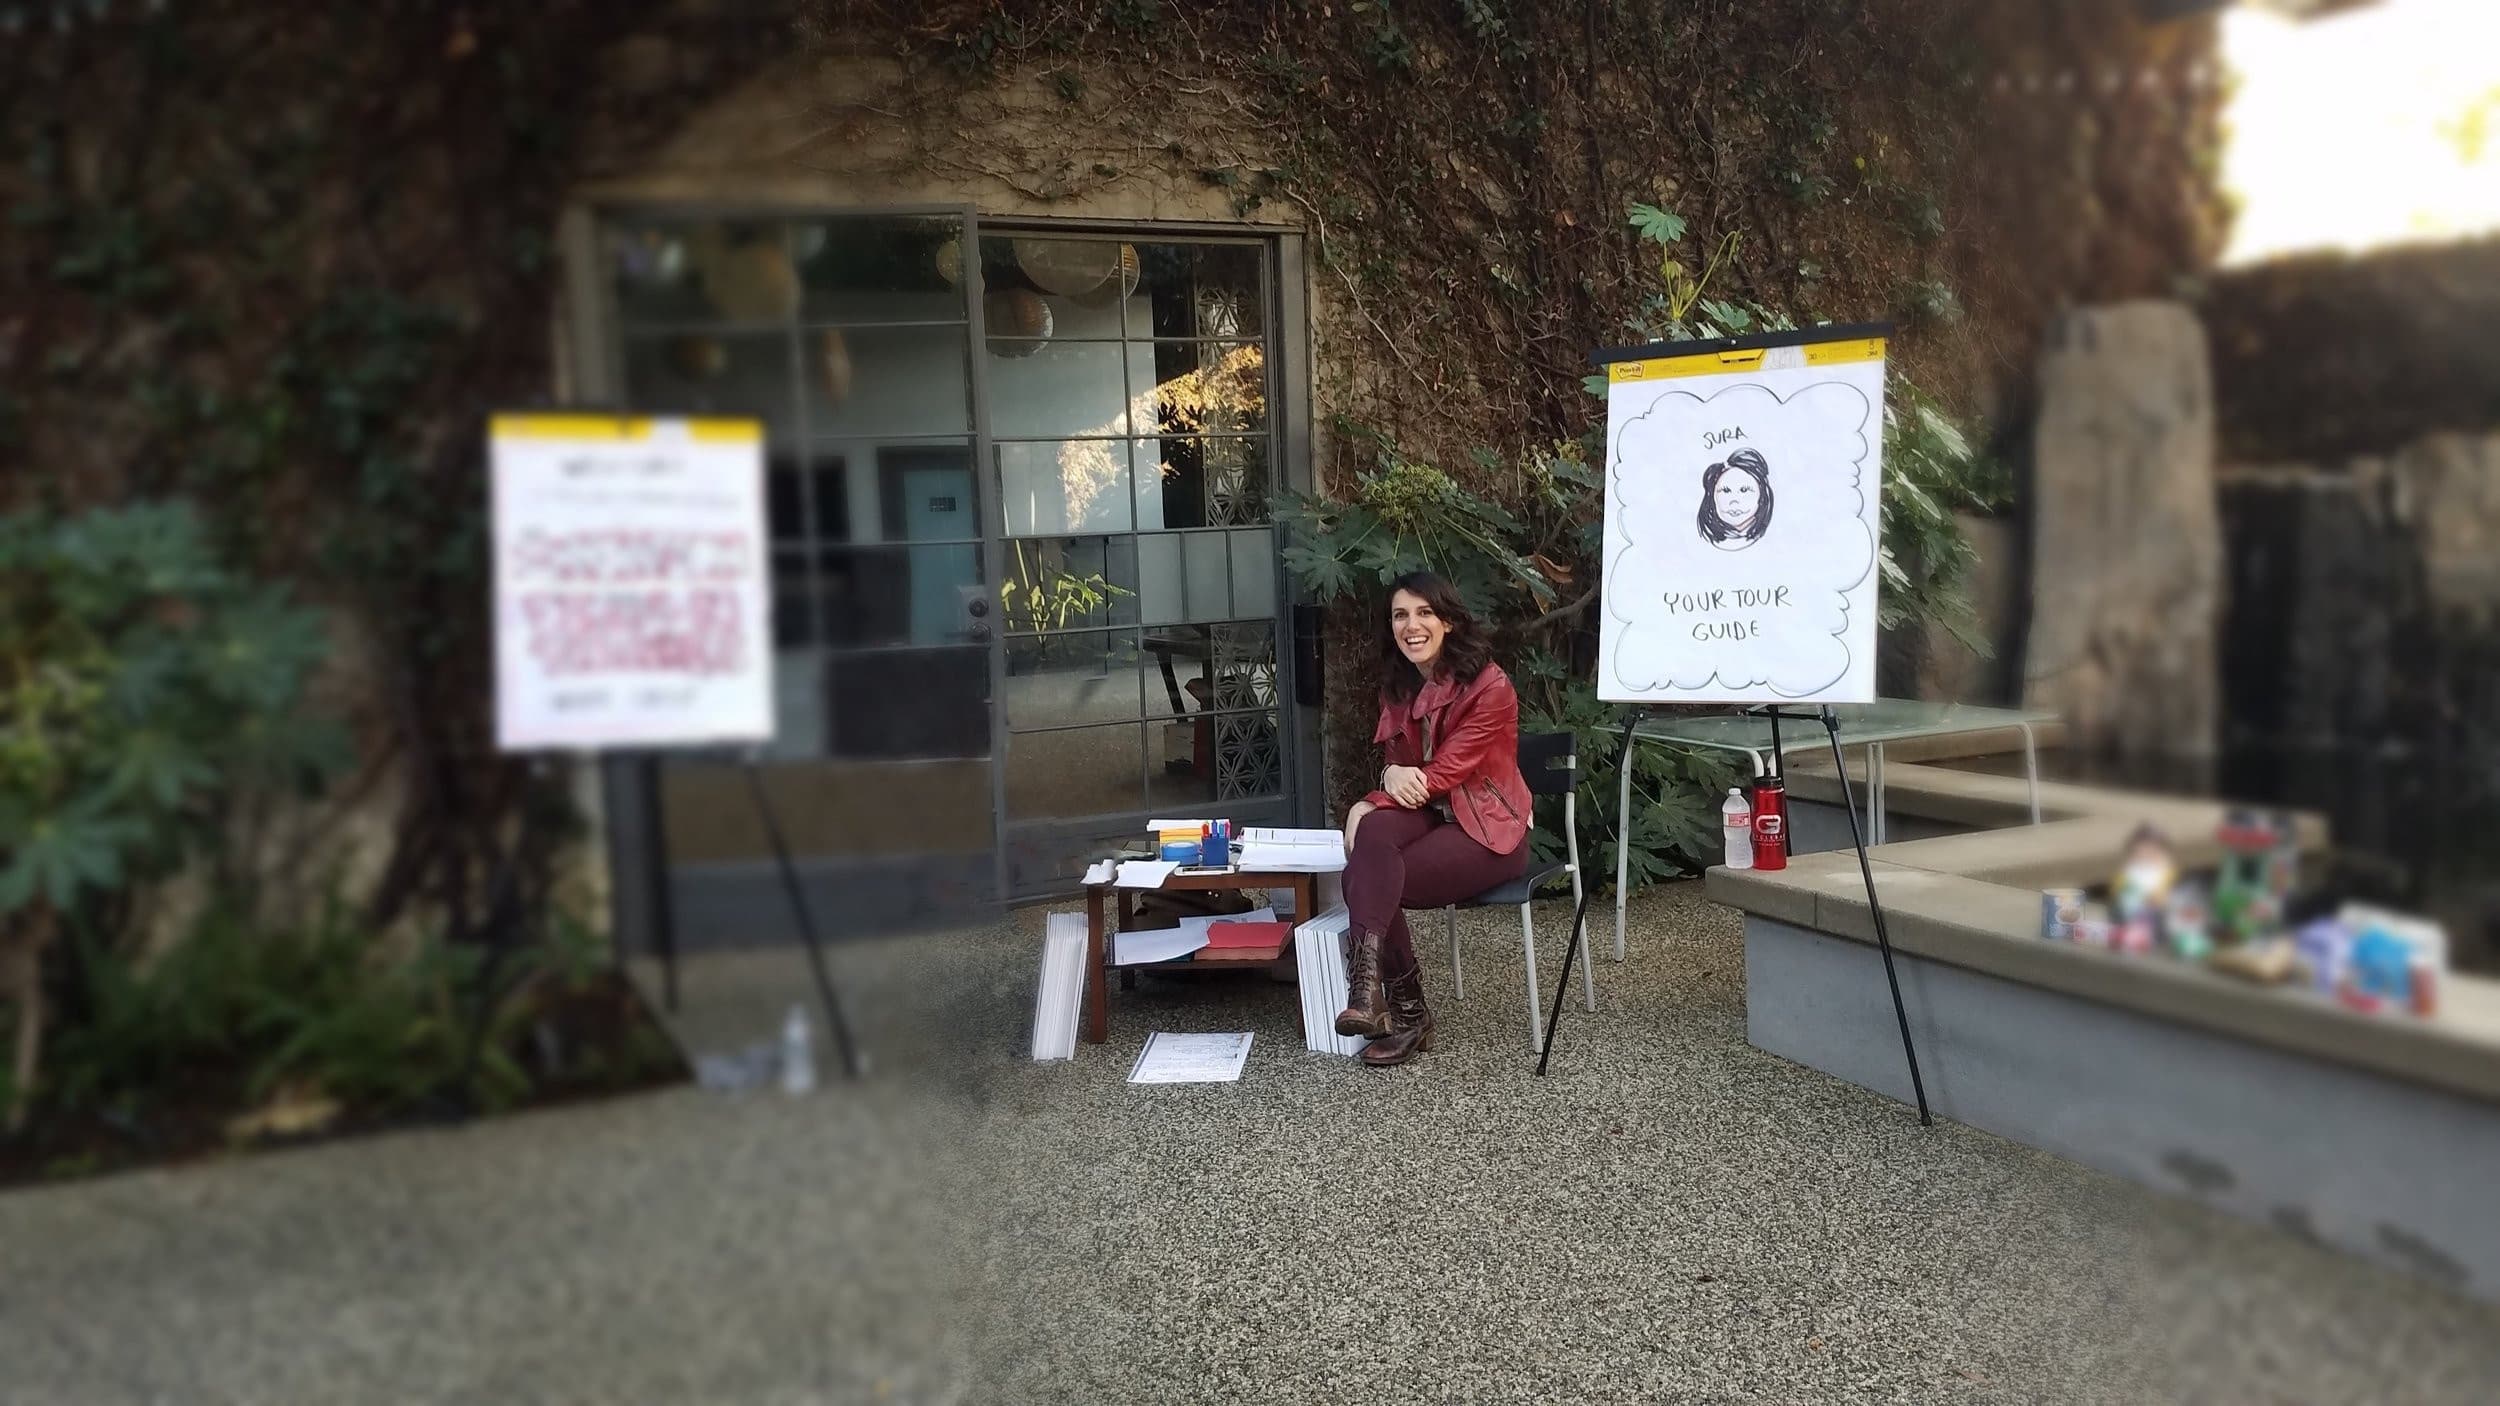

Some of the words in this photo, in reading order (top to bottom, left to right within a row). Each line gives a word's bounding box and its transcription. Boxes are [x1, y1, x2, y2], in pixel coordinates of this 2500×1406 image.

[1703, 425, 1749, 450] SURA
[1663, 588, 1727, 615] YOUR
[1731, 585, 1793, 608] TOUR
[1692, 619, 1760, 642] GUIDE
